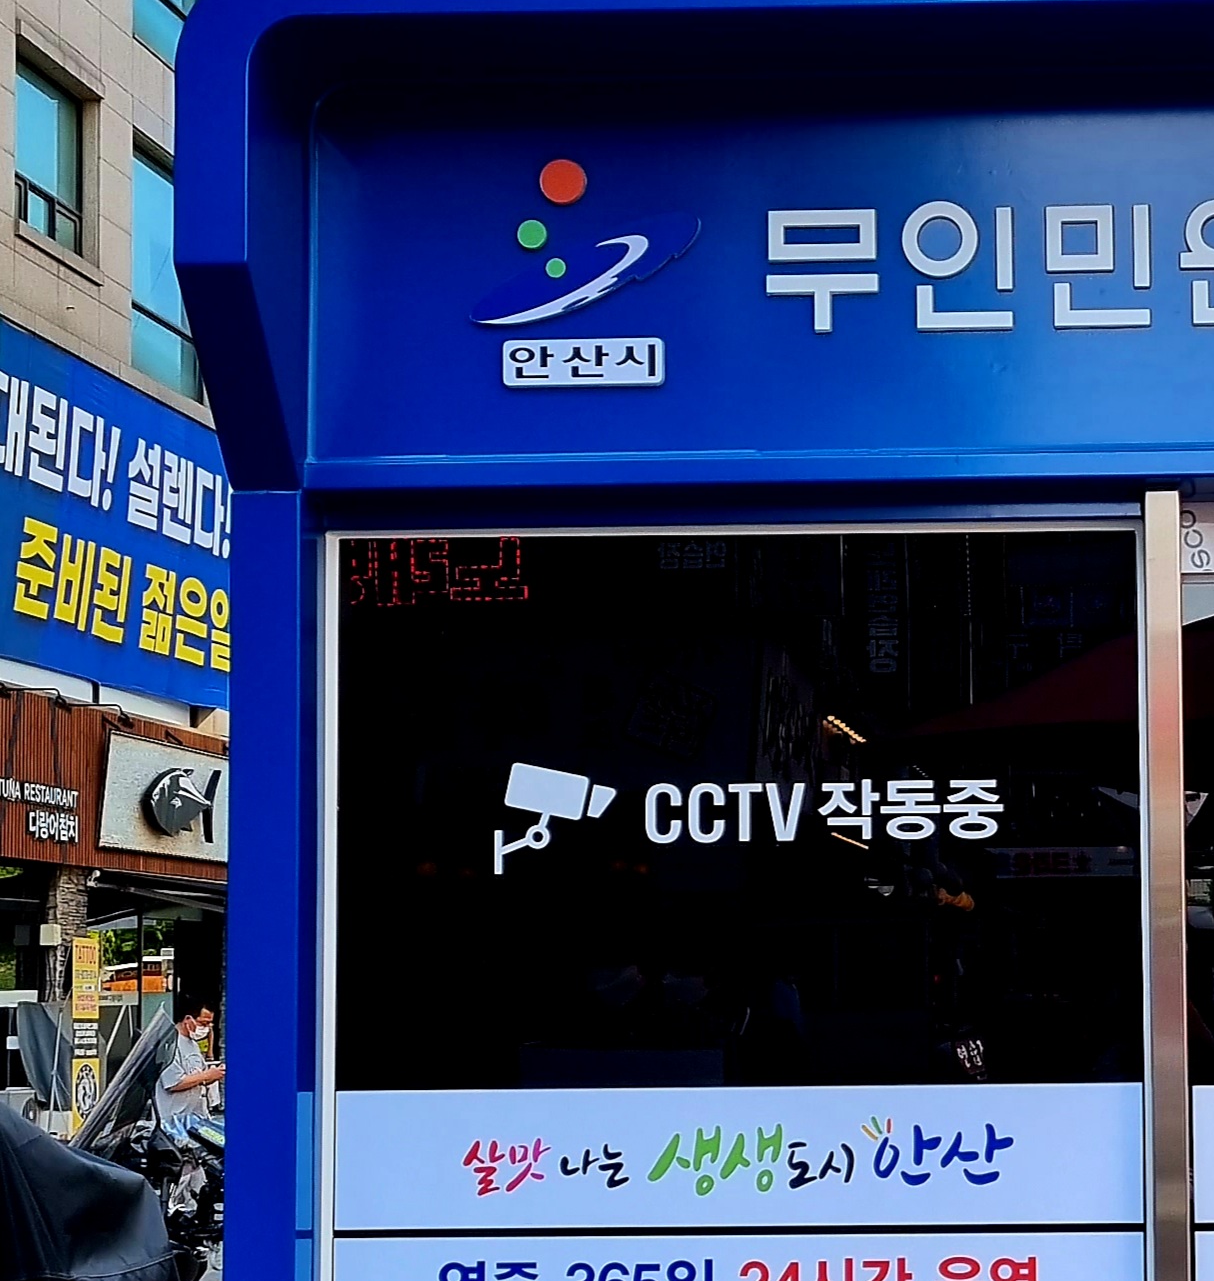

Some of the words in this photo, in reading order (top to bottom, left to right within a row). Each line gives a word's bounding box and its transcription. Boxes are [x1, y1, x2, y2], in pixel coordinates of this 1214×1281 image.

[507, 342, 659, 380] 안산시
[13, 516, 133, 645] 준비된
[23, 780, 79, 810] RESTAURANT
[645, 782, 805, 844] CCTV
[817, 779, 1005, 841] 작동중
[27, 810, 79, 843] 다랑어참치
[872, 1121, 1015, 1186] 안산
